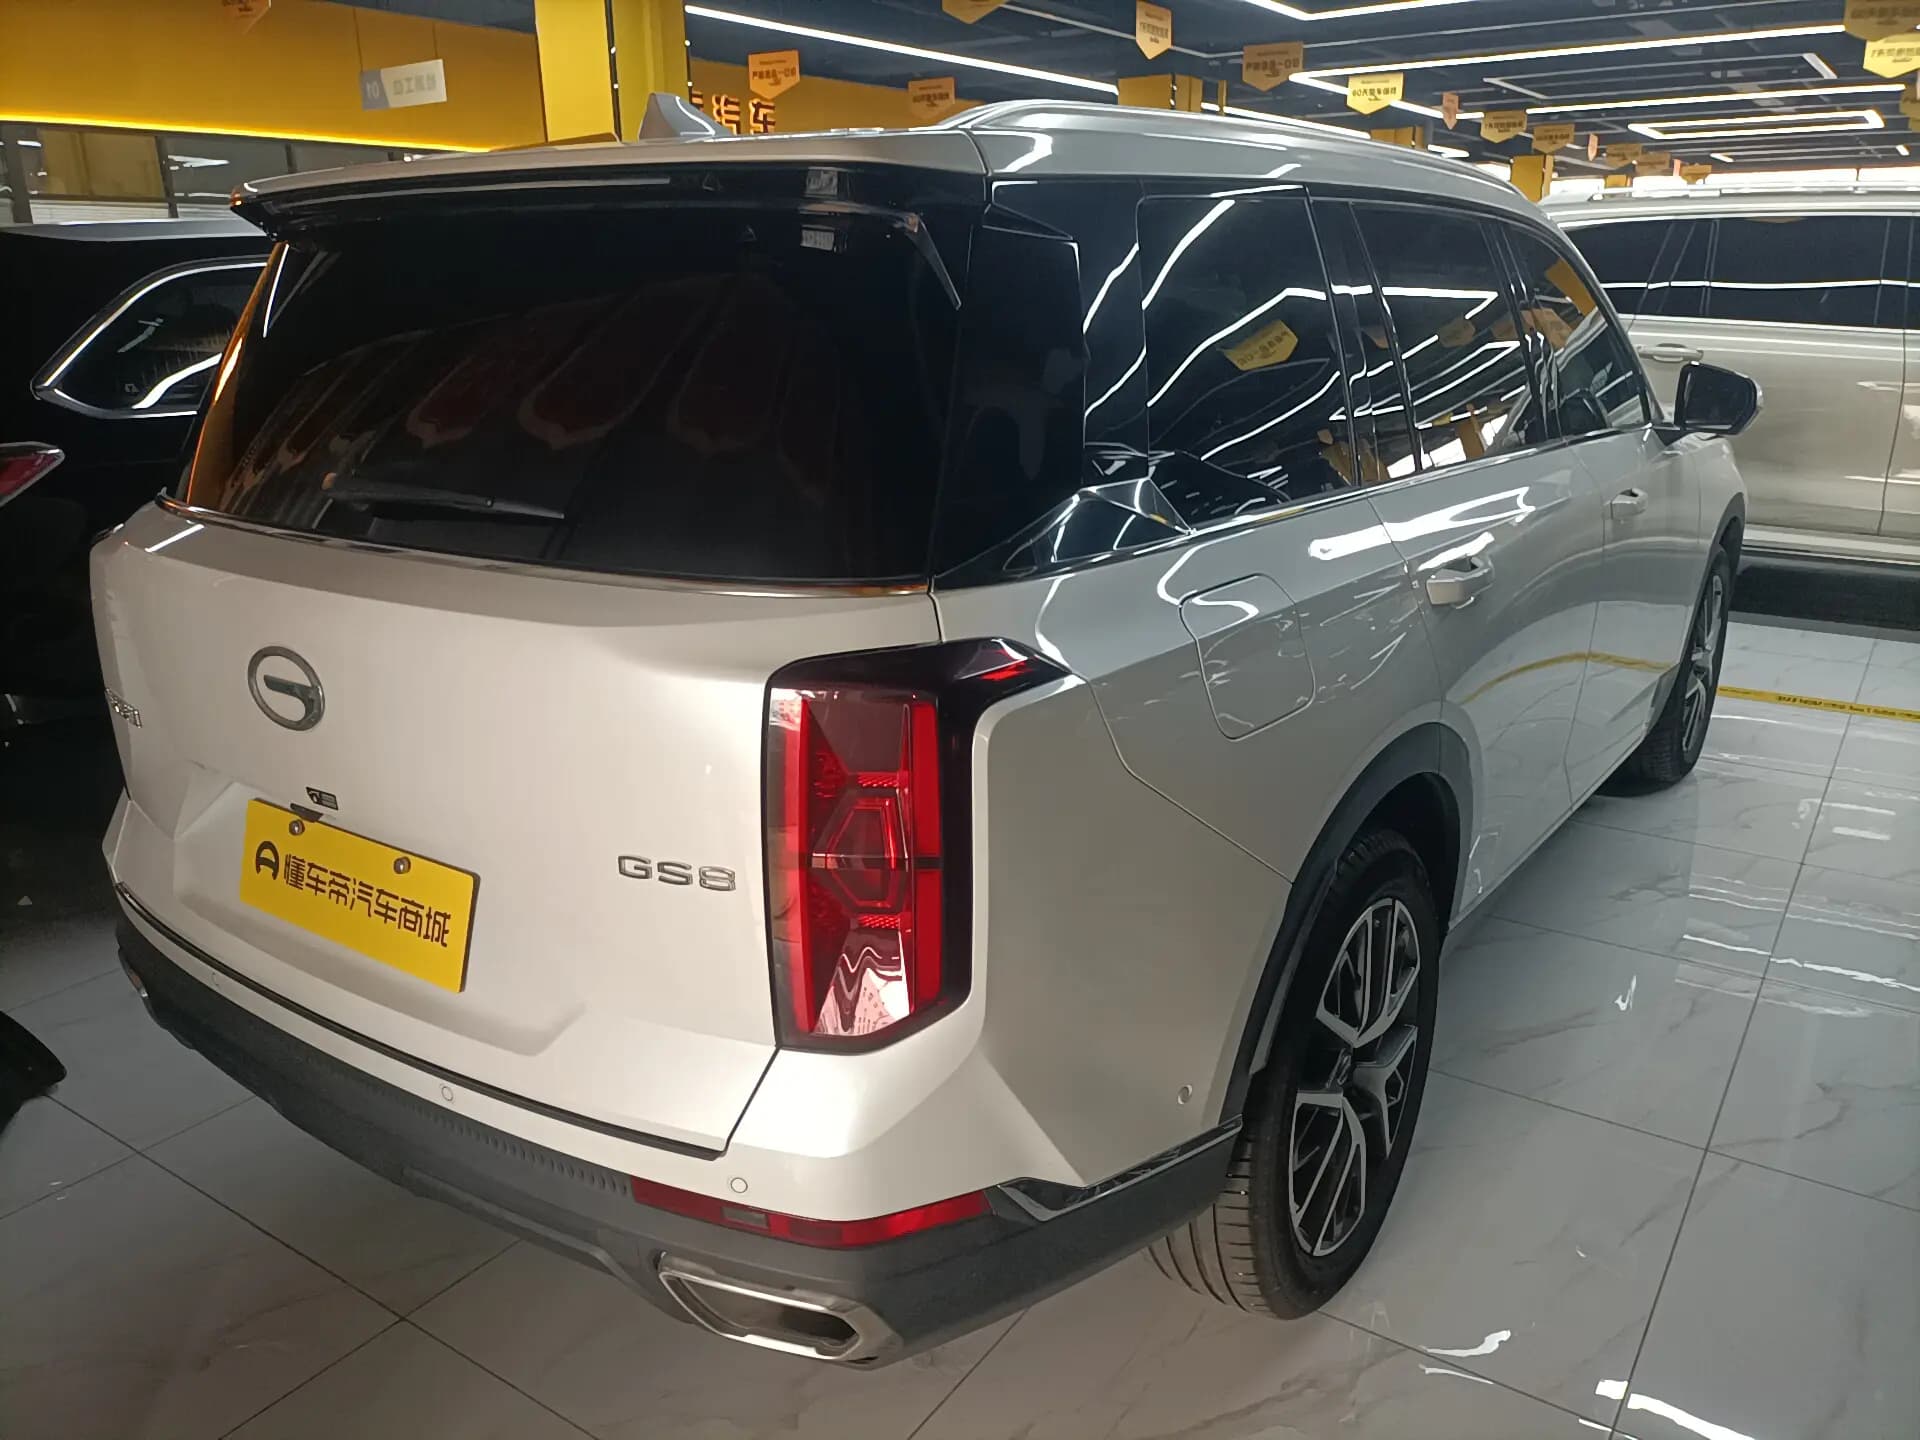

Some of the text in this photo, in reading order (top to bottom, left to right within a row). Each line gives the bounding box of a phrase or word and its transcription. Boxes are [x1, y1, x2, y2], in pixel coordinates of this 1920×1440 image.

[283, 852, 452, 948] 懂车帝汽车商城
[617, 854, 737, 892] GS8
